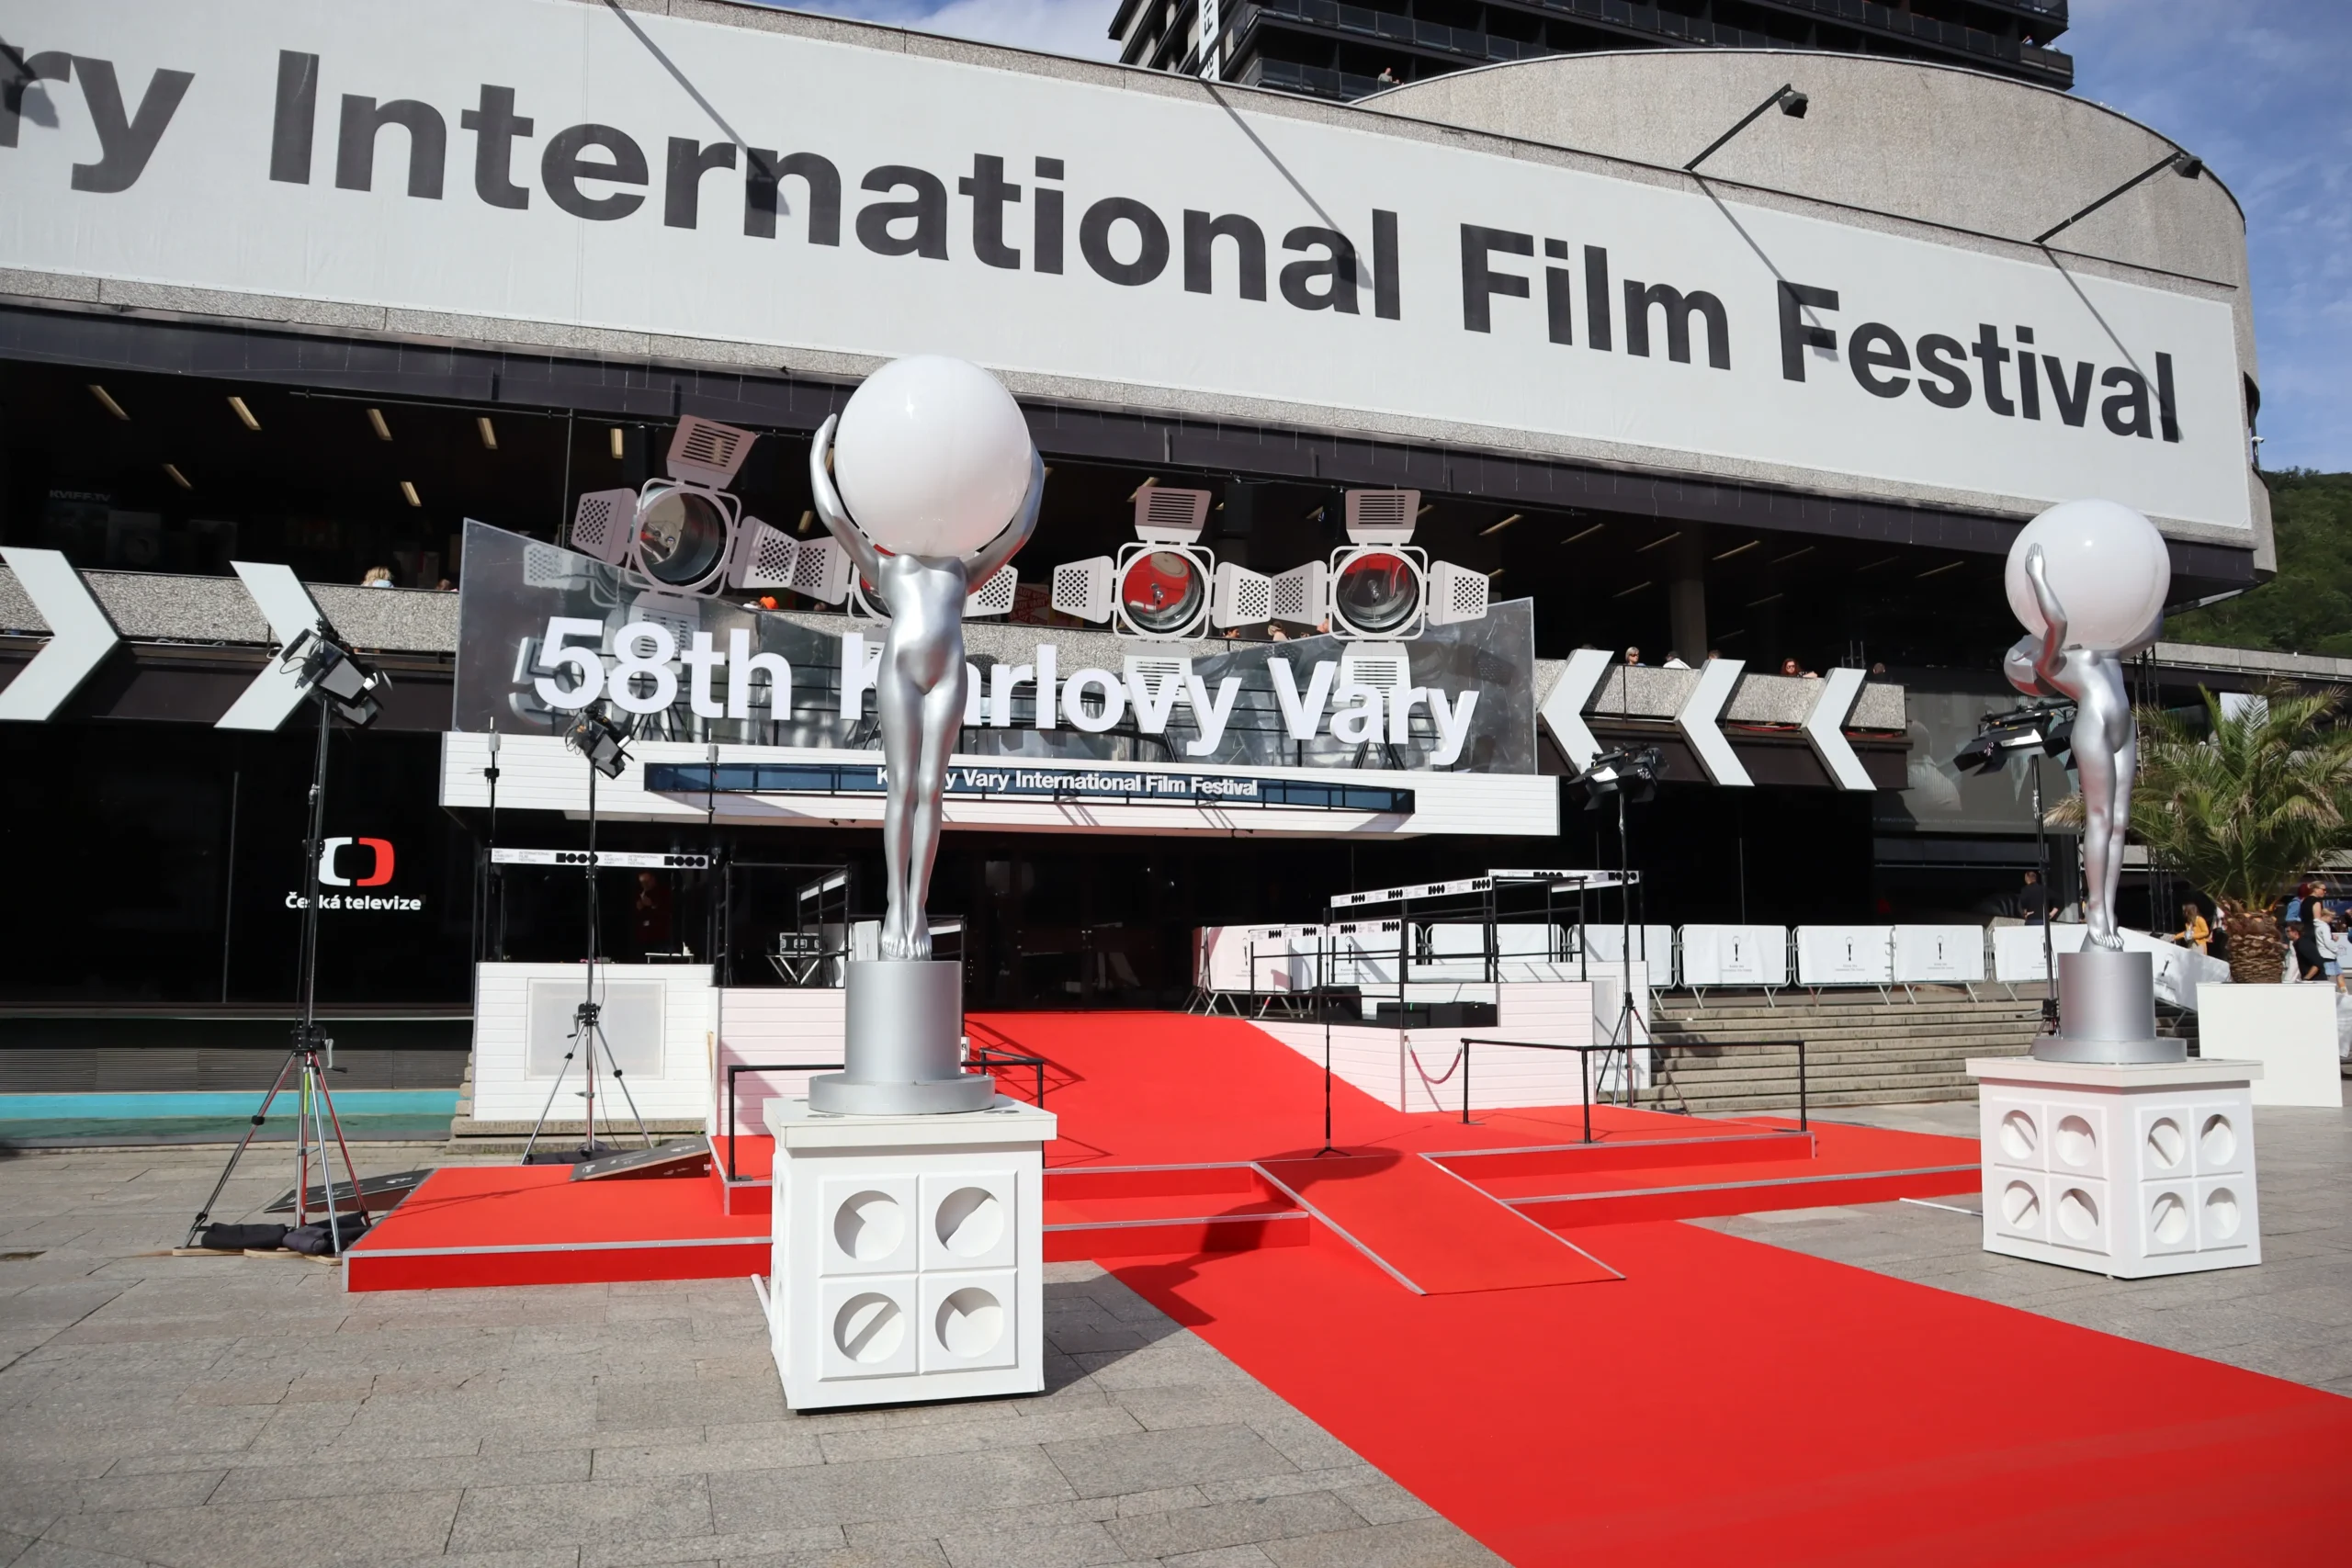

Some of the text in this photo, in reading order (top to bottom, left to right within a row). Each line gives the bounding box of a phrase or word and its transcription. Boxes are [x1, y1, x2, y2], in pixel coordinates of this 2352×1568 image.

[270, 51, 1401, 321] International
[1461, 223, 1731, 371] Film
[1778, 280, 2180, 444] Festival
[49, 490, 111, 502] KVIFF.TV
[535, 616, 1480, 766] 58th Krlovy Vary
[962, 769, 1010, 792] Vary
[1015, 770, 1141, 792] International
[1146, 774, 1186, 793] Film
[1192, 777, 1258, 796] Festival
[285, 891, 422, 910] Čeká televize
